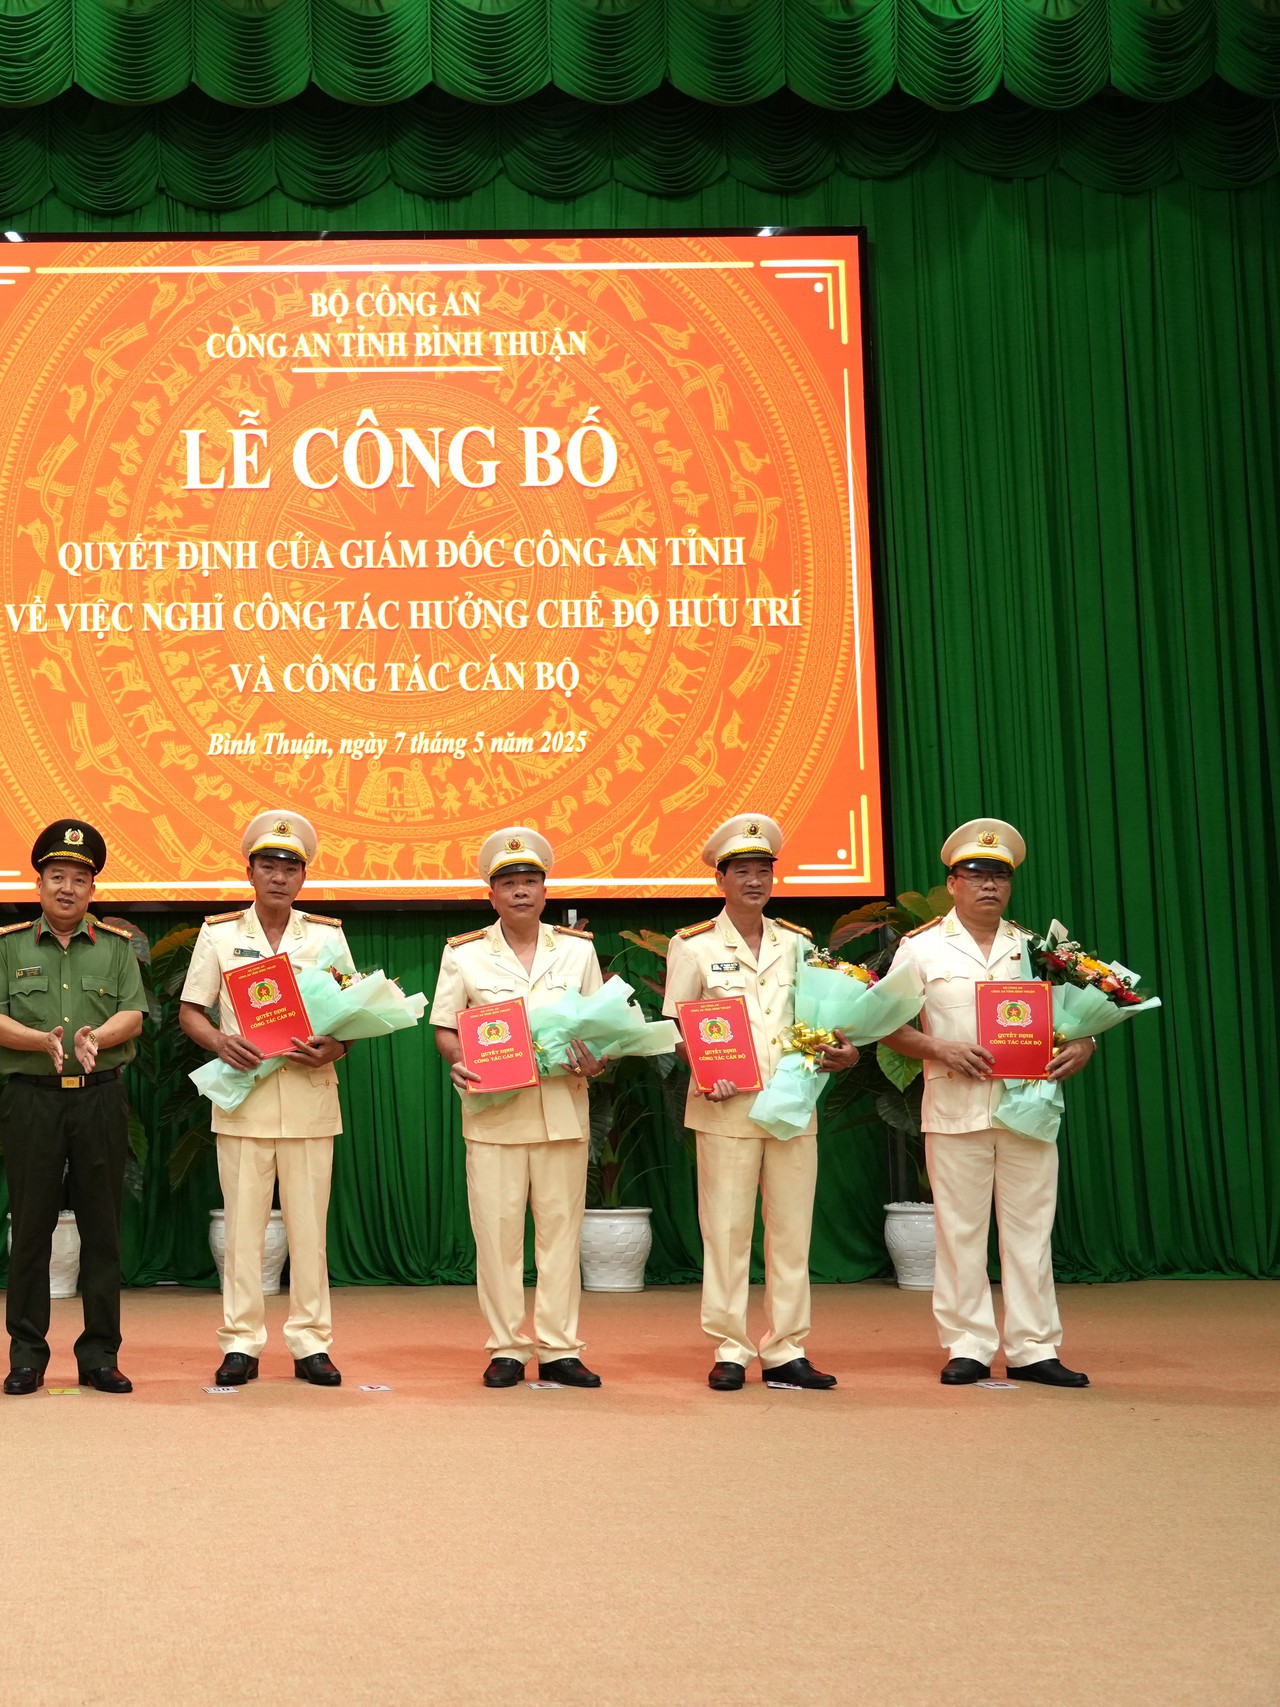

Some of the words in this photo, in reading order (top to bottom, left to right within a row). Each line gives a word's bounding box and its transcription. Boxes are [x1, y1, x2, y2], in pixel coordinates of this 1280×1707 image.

[310, 288, 349, 319] BỘ
[356, 284, 437, 317] CÔNG
[442, 291, 480, 316] AN
[206, 326, 287, 358] CÔNG
[293, 333, 331, 357] AN
[337, 325, 407, 357] TỈNH
[414, 325, 483, 356] BÌNH
[489, 328, 587, 362] THUẬN
[180, 409, 271, 490] LỄ
[292, 408, 501, 490] CÔNG
[518, 406, 618, 488] BỐ
[58, 534, 168, 576] QUYẾT
[176, 540, 258, 577] ĐỊNH
[267, 532, 334, 569] CỦA
[340, 532, 428, 568] GIÁM
[436, 530, 504, 568] ĐỐC
[514, 529, 606, 567] CÔNG
[613, 537, 657, 567] AN
[666, 528, 746, 566] TỈNH
[5, 596, 48, 632] VỀ
[56, 599, 133, 639] VIỆC
[142, 593, 224, 631] NGHỈ
[233, 592, 327, 630] CÔNG
[334, 593, 399, 630] TÁC
[408, 592, 528, 629] HƯỞNG
[537, 591, 604, 628] CHẾ
[612, 594, 659, 635] ĐỘ
[668, 594, 738, 627] HƯU
[746, 590, 802, 627] TRÍ
[229, 656, 275, 693] VÀ
[283, 654, 376, 692] CÔNG
[384, 654, 450, 692] TÁC
[458, 654, 526, 691] CÁN
[534, 657, 580, 698] BỘ
[207, 733, 256, 756] Bình
[263, 733, 333, 760] Thuận,
[340, 732, 387, 761] ngày
[394, 731, 407, 753] 7
[410, 731, 467, 760] tháng
[472, 731, 485, 753] 5
[490, 731, 533, 753] năm
[539, 730, 588, 753] 2025
